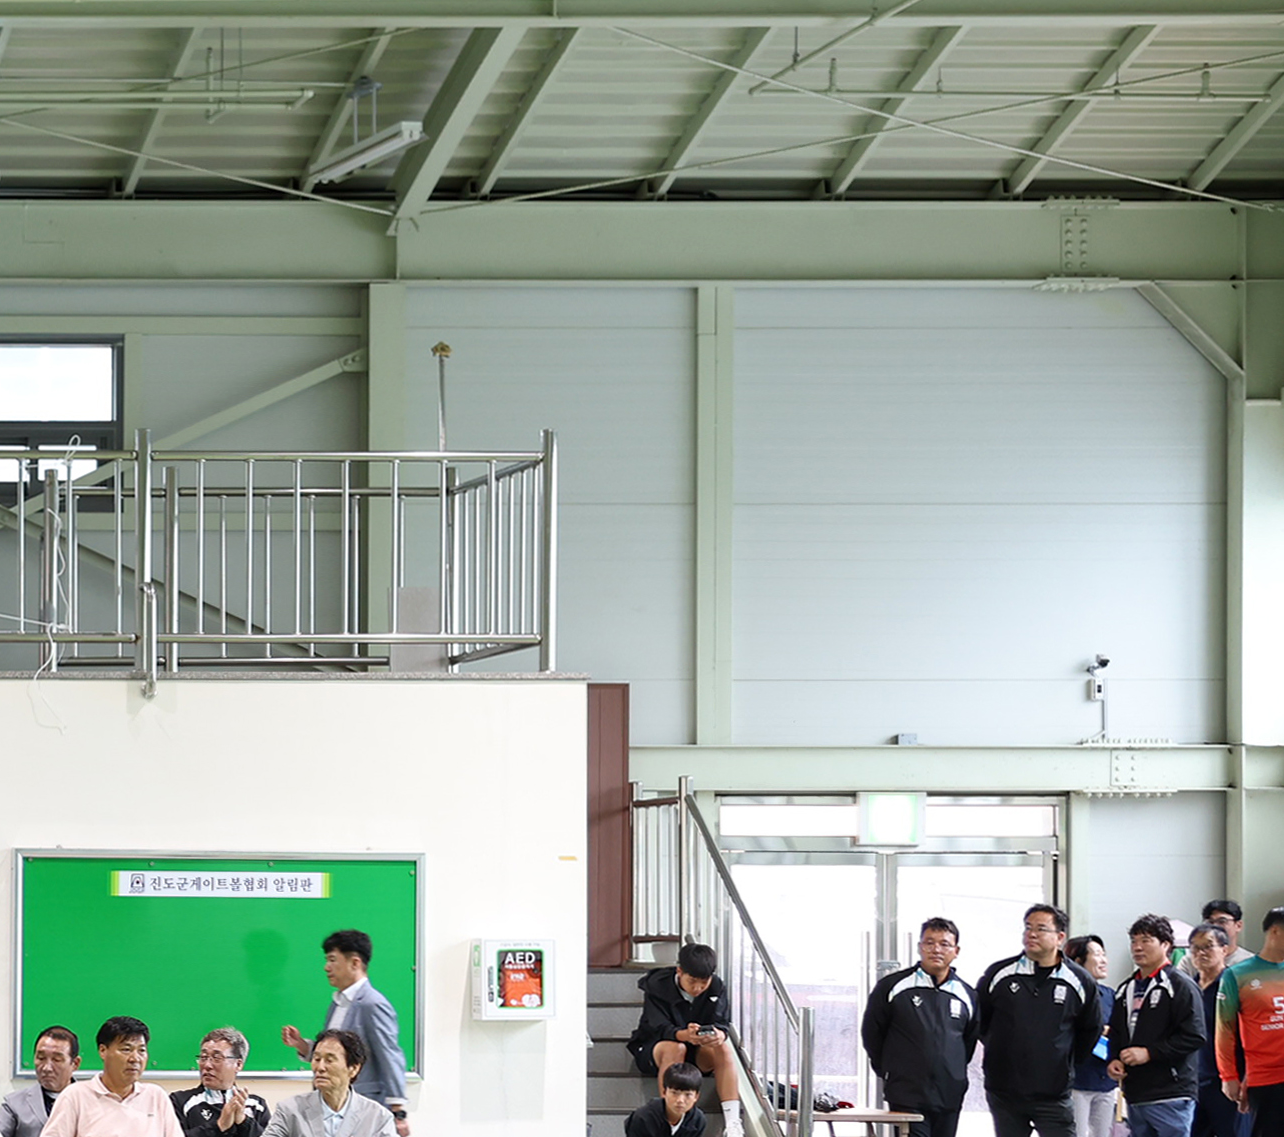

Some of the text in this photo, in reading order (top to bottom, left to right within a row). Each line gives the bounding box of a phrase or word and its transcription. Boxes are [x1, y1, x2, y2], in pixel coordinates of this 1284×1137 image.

[149, 876, 313, 893] 진도군게이트볼협회 알림판
[505, 952, 535, 964] AED
